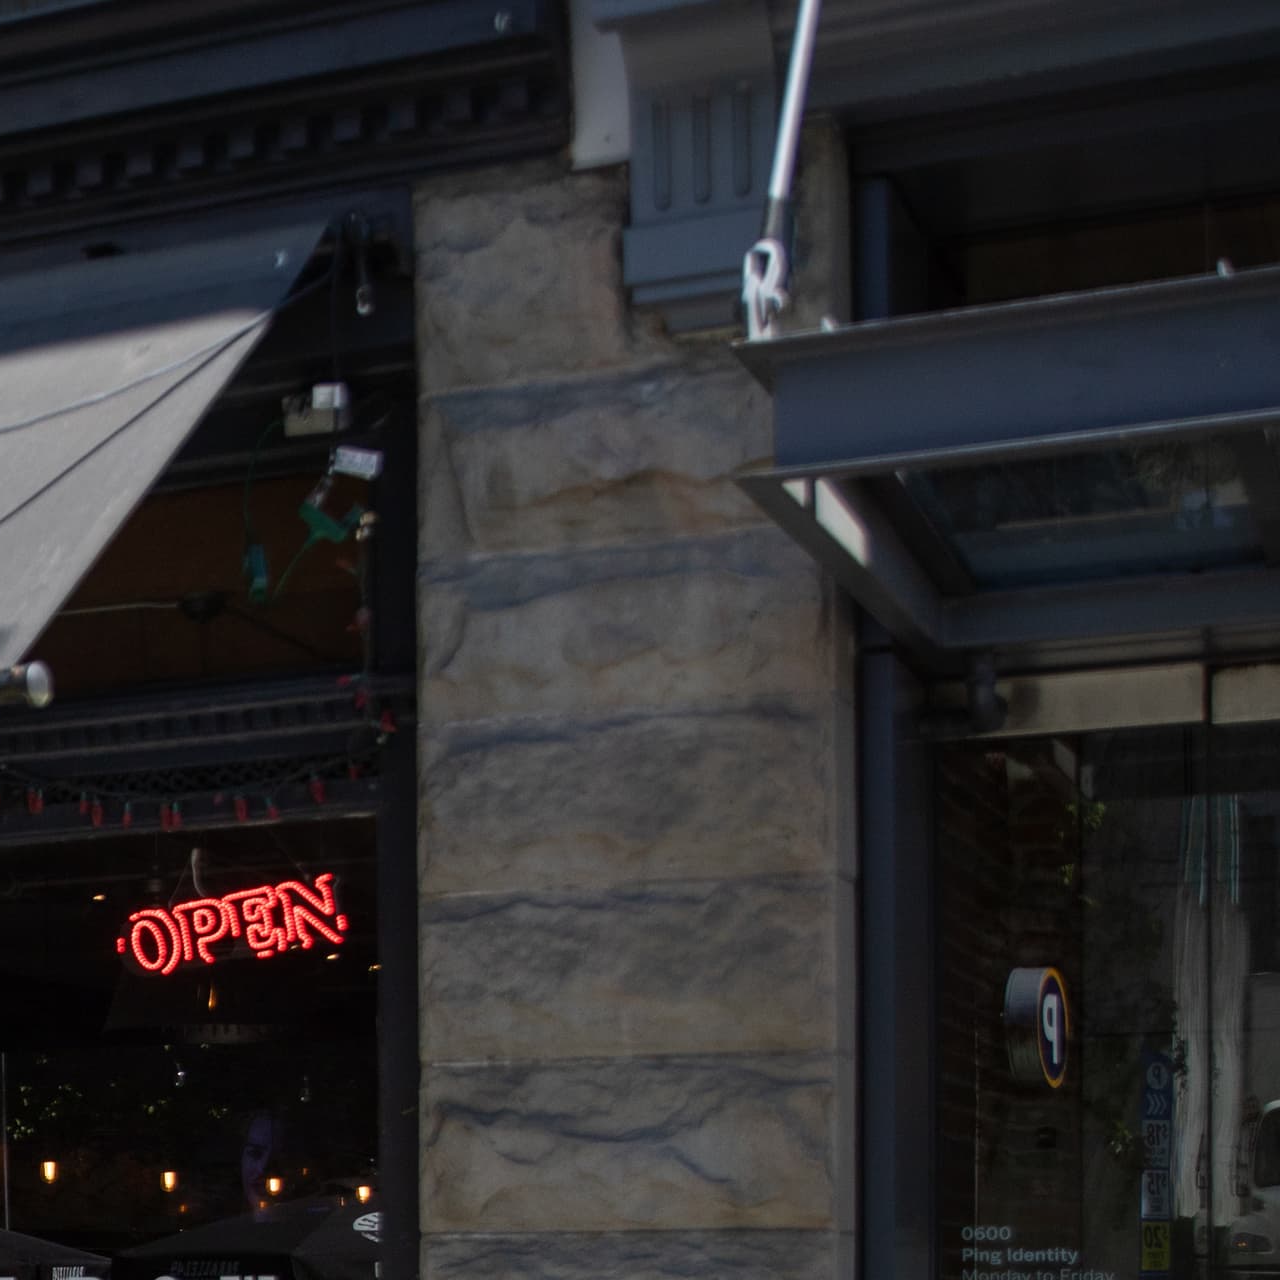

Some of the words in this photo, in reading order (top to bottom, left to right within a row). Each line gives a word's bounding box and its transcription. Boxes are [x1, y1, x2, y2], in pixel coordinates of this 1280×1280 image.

[127, 871, 347, 977] OPEN
[960, 1226, 1011, 1241] 0600
[961, 1248, 1002, 1265] Ping
[1007, 1247, 1079, 1264] Identity
